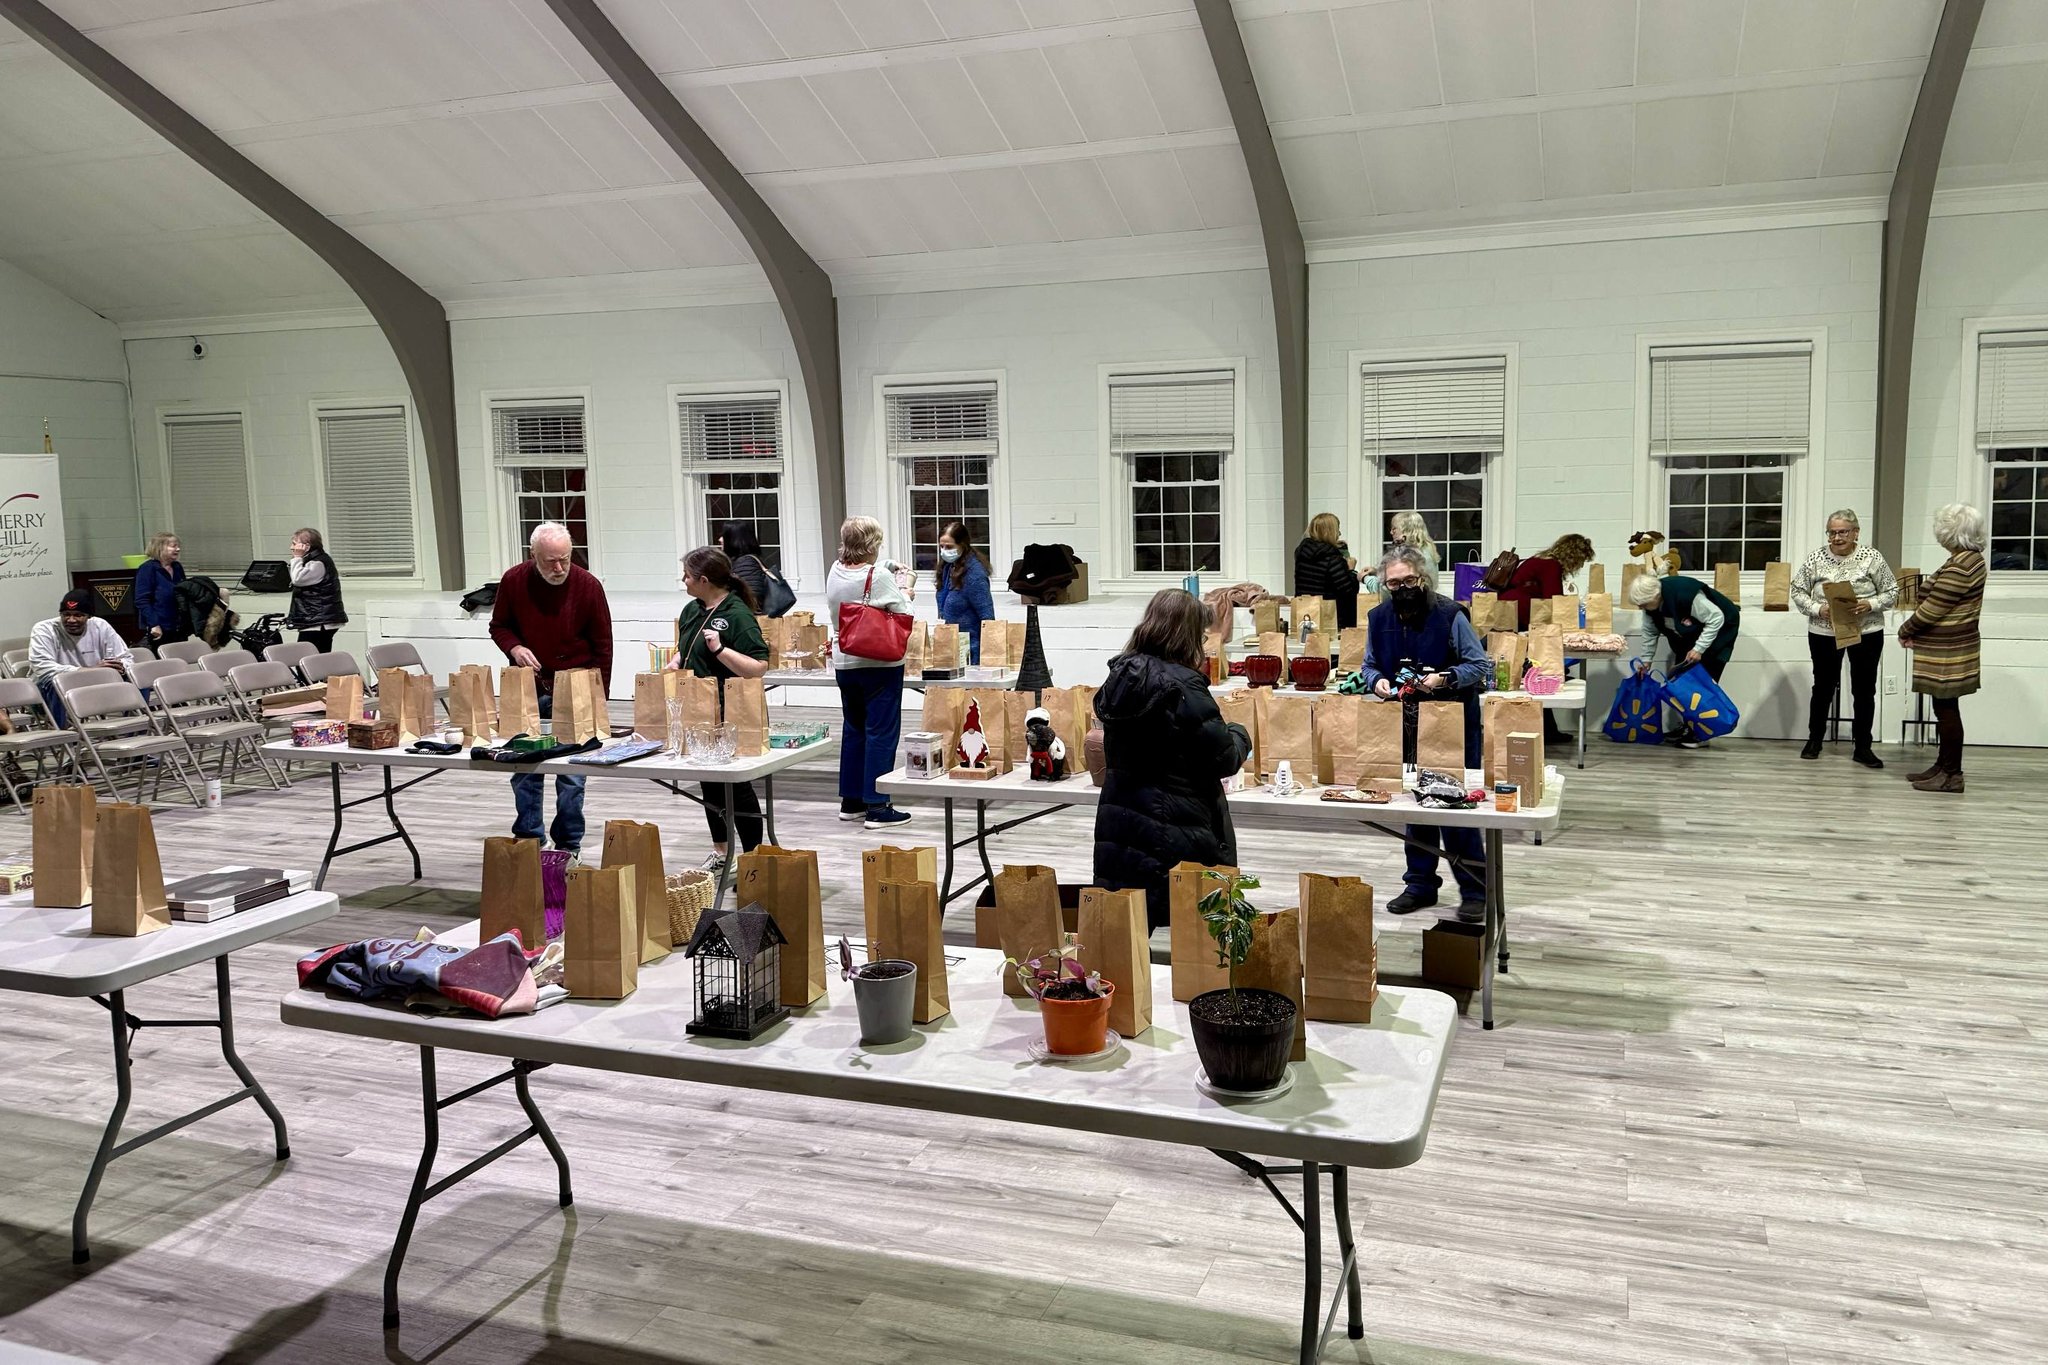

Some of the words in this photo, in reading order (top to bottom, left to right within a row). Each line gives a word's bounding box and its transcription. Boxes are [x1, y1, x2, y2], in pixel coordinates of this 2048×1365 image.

[609, 834, 615, 848] 4
[569, 872, 578, 880] 67
[744, 869, 759, 883] 15
[1083, 894, 1092, 903] 70
